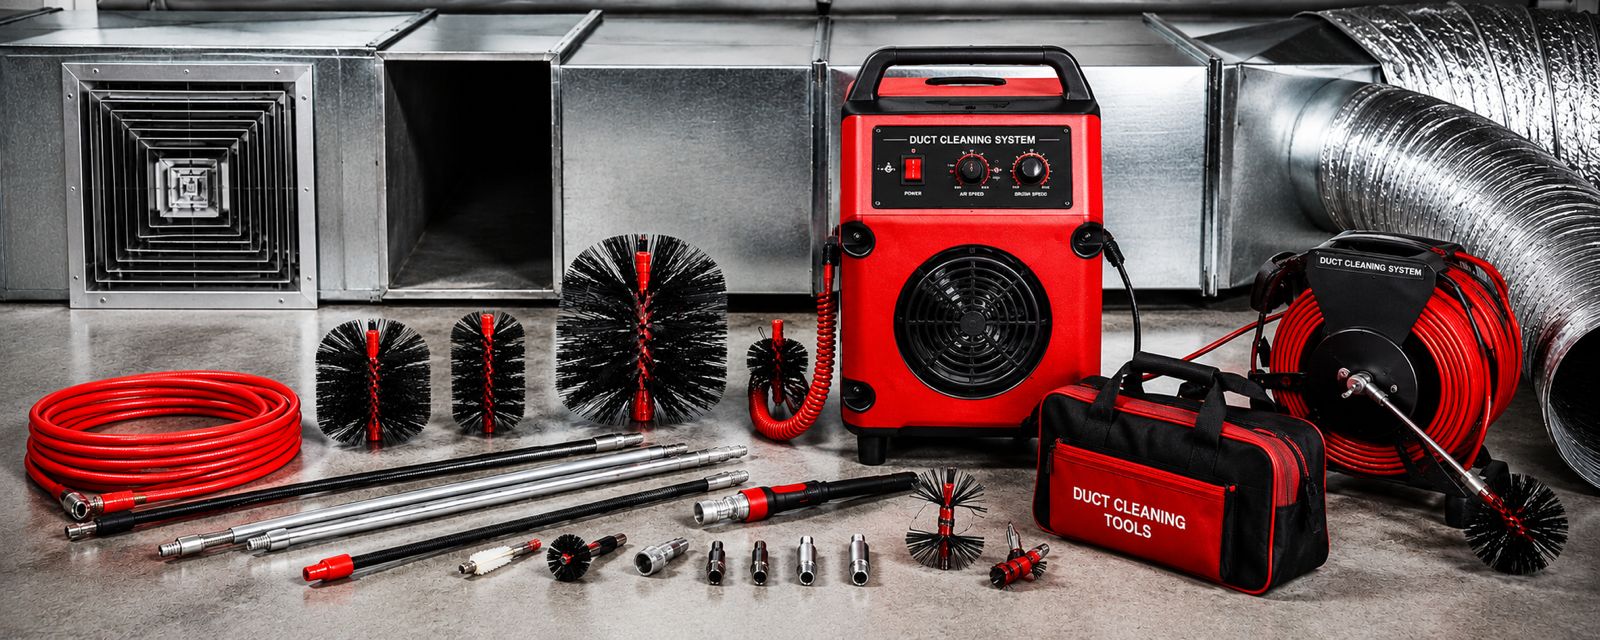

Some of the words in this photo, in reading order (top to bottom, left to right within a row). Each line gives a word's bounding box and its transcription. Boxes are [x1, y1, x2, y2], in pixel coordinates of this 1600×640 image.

[909, 135, 938, 144] DUCT
[939, 135, 992, 144] CLEANING
[994, 135, 1036, 144] SYSTEM
[1319, 256, 1343, 266] DUCT
[1344, 259, 1386, 272] CLEANING
[1388, 265, 1422, 276] SYSTEM
[1073, 486, 1110, 508] DUCT
[1113, 498, 1186, 530] CLEANING
[1104, 513, 1152, 539] TOOLS
